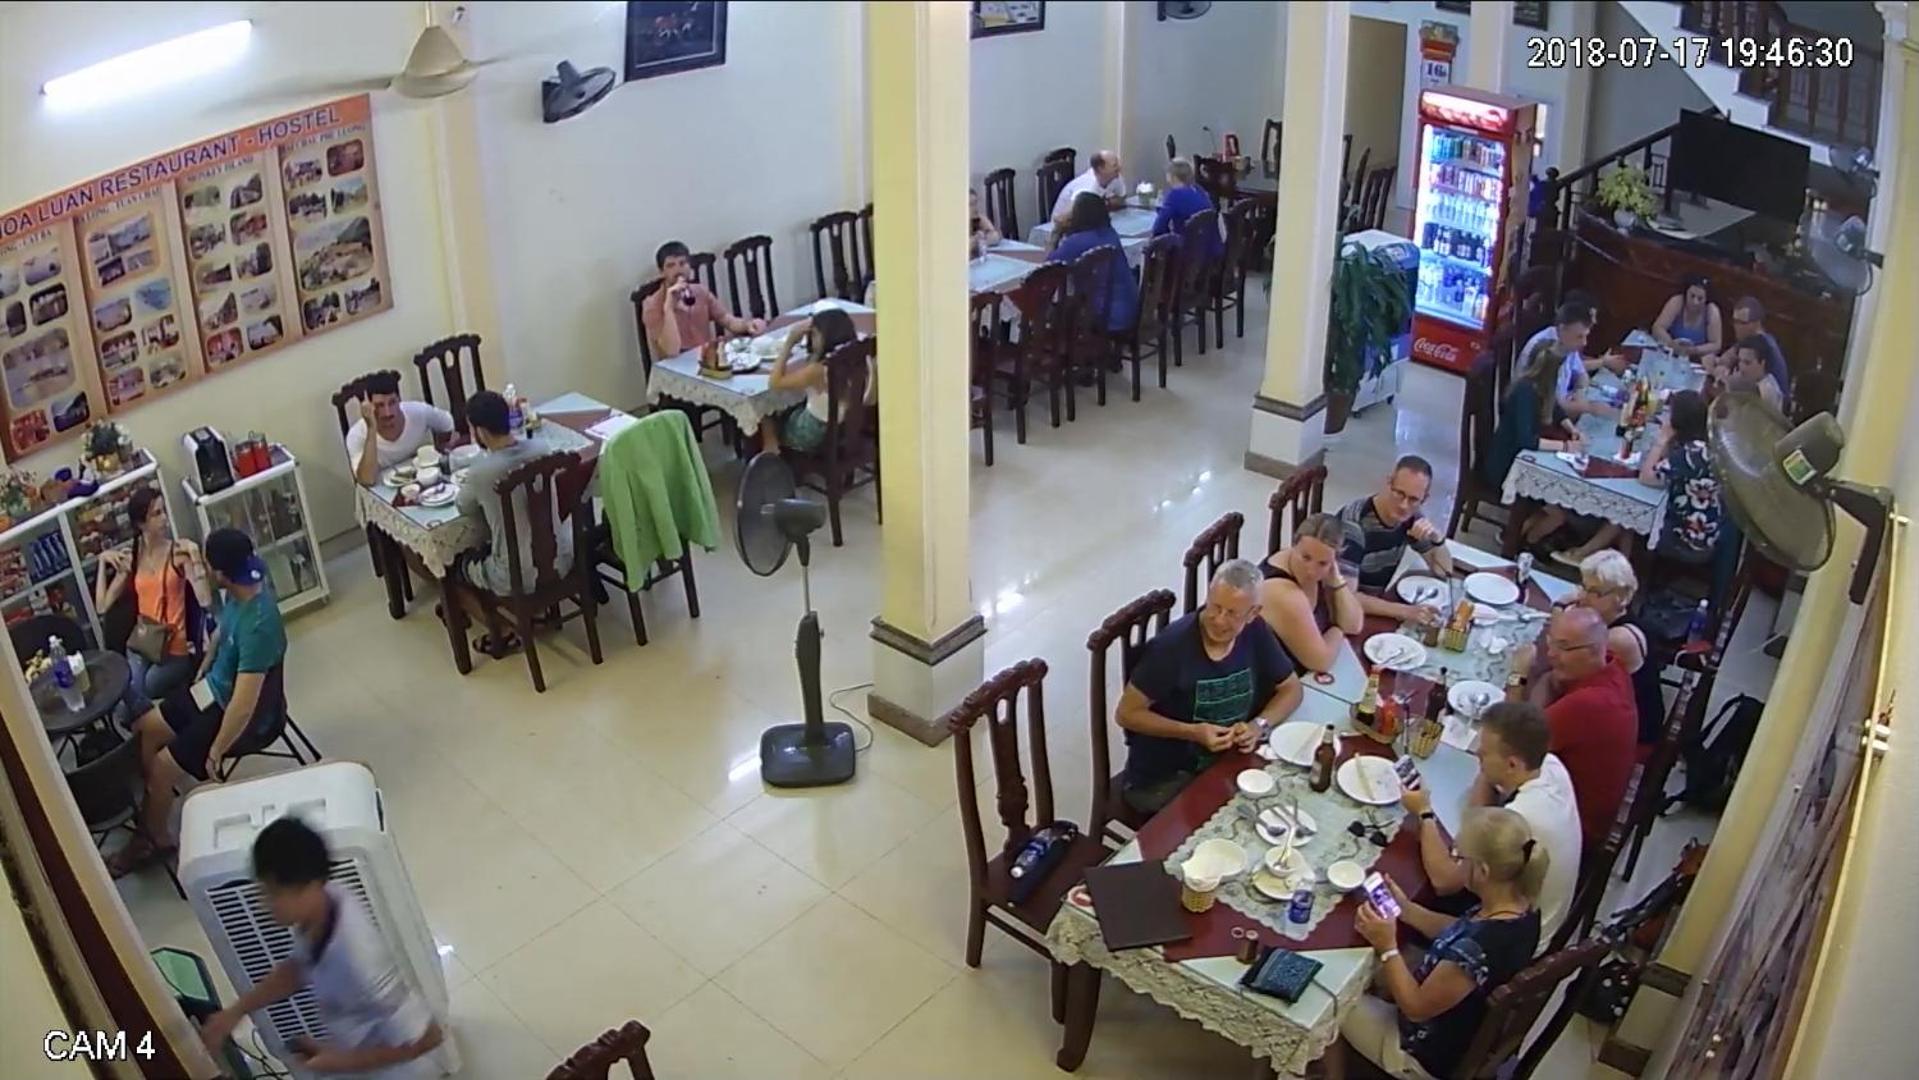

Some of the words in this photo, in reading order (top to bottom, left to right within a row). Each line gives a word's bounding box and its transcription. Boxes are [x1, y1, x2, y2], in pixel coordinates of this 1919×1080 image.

[38, 186, 94, 222] LUAN
[100, 136, 239, 198] RESTAURANT
[258, 107, 341, 144] HOSTEL
